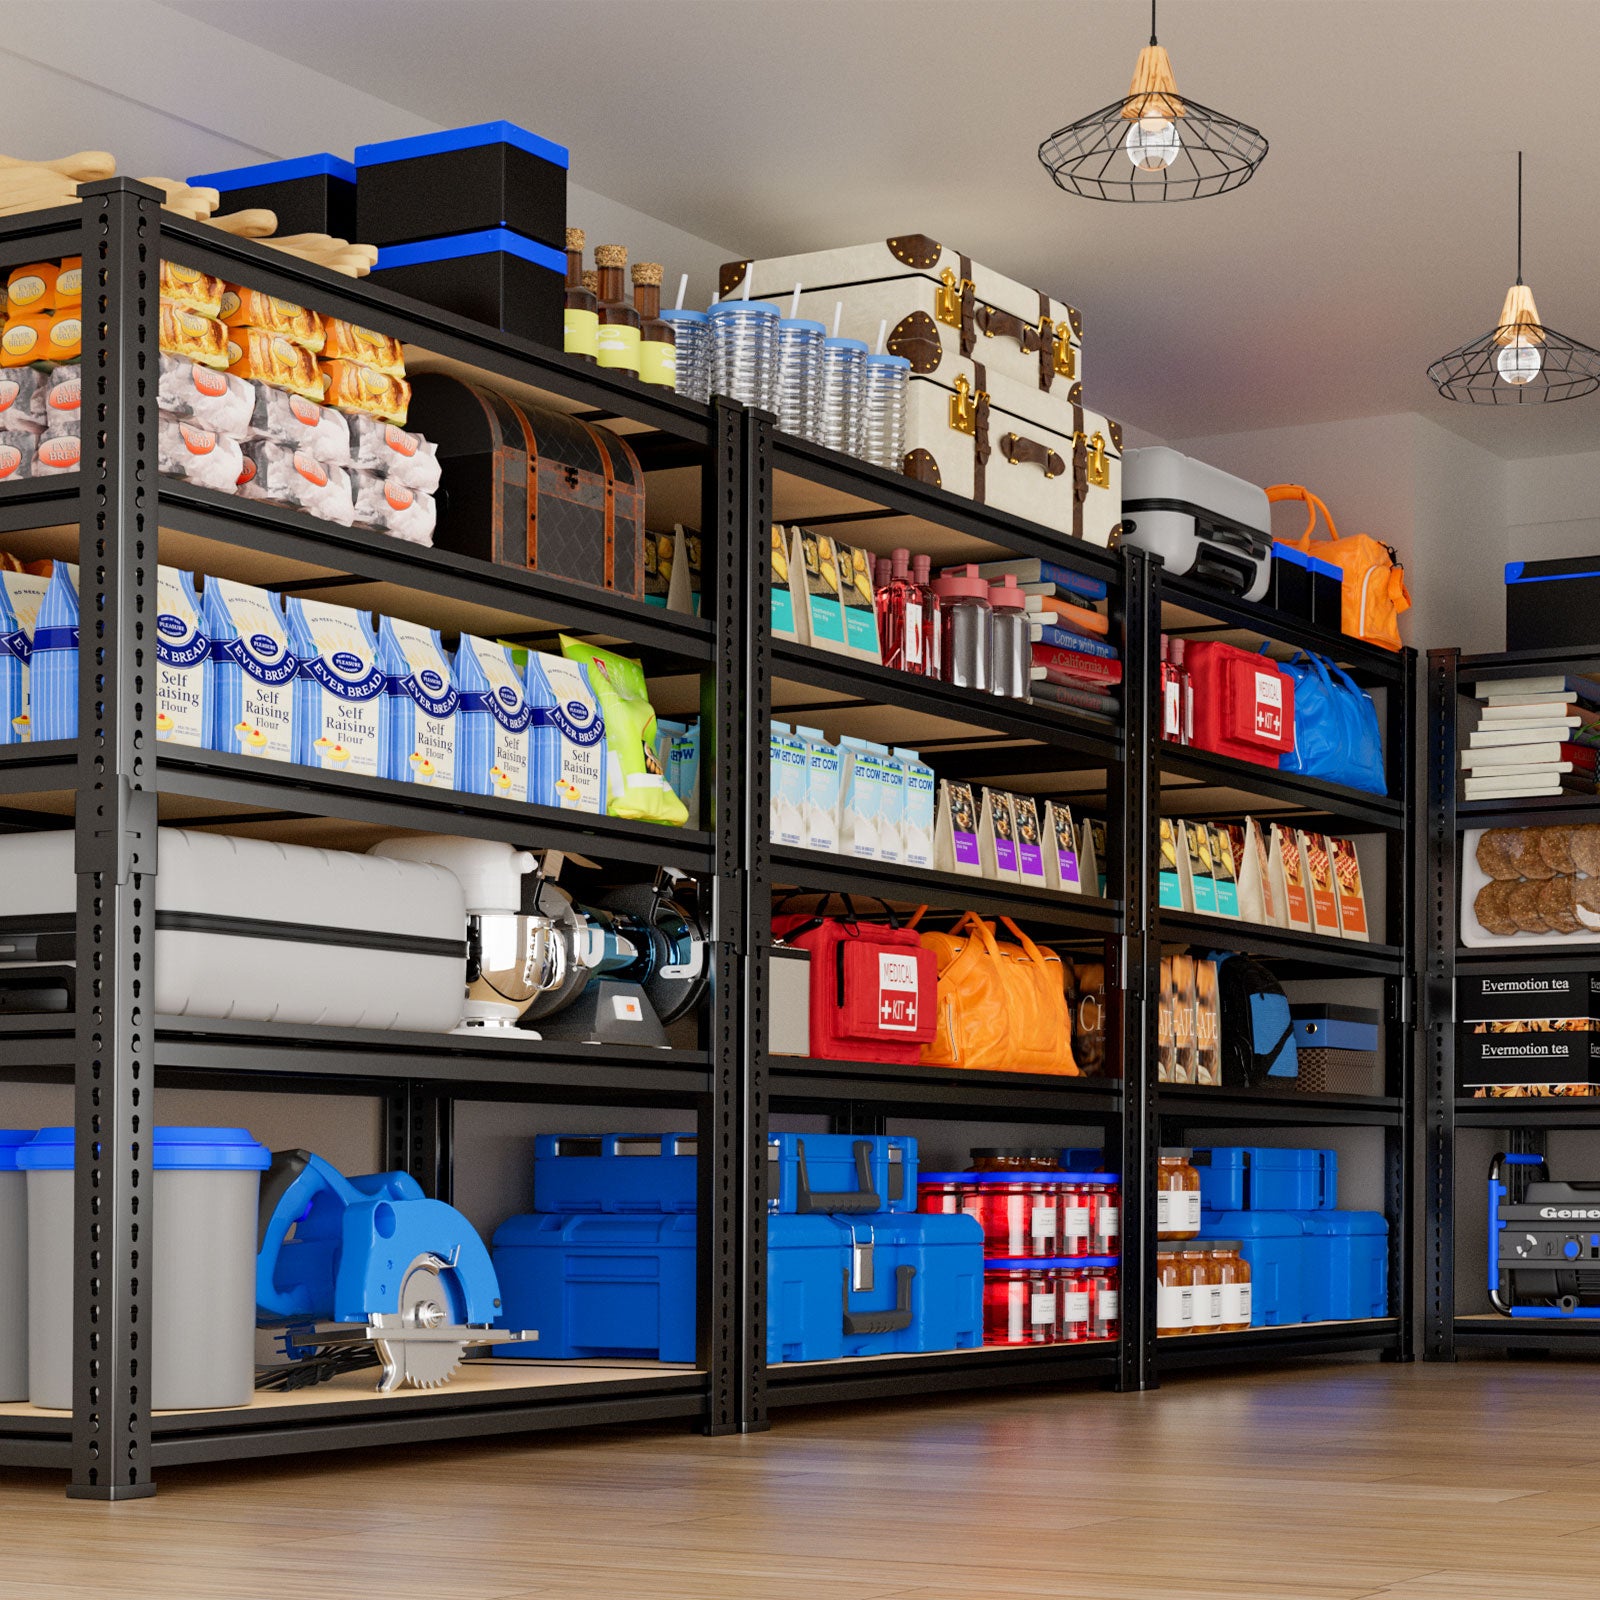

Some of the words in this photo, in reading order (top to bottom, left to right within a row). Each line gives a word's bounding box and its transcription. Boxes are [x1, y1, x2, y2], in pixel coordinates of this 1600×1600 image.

[171, 638, 206, 662] BREAD
[1054, 629, 1078, 650] Come
[1079, 638, 1096, 655] with
[1097, 647, 1110, 659] me
[235, 644, 263, 678] EVER
[265, 657, 295, 681] BREAD
[1057, 652, 1102, 673] California
[162, 671, 188, 687] Self
[314, 662, 345, 695] EVER
[347, 673, 382, 697] BREAD
[156, 687, 199, 707] aising
[256, 688, 280, 704] Self
[408, 679, 432, 712] EVER
[432, 691, 456, 714] BREAD
[161, 700, 188, 714] Flour
[246, 700, 290, 723] Raising
[338, 705, 364, 720] Self
[488, 696, 509, 726] EVER
[509, 707, 529, 729] BREAD
[256, 717, 280, 730] Flour
[326, 716, 376, 738] Raising
[426, 721, 445, 736] Self
[554, 710, 578, 740] EVER
[579, 721, 603, 743] BREAD
[337, 732, 363, 745] Flour
[418, 732, 453, 753] Raising
[504, 736, 520, 750] Self
[426, 747, 445, 760] Flour
[497, 746, 527, 767] Raising
[572, 750, 591, 763] Self
[792, 753, 806, 766] COW
[503, 761, 520, 773] Flour
[564, 760, 598, 780] Raising
[823, 758, 838, 771] COW
[572, 774, 591, 786] Flour
[866, 768, 881, 780] COW
[919, 779, 933, 791] COW
[884, 962, 913, 984] MEDICAL
[1482, 978, 1549, 991] Evermotion
[1552, 979, 1570, 989] tea
[893, 1000, 905, 1020] KIT
[1481, 1043, 1549, 1056] Evermotion
[1551, 1044, 1569, 1054] tea
